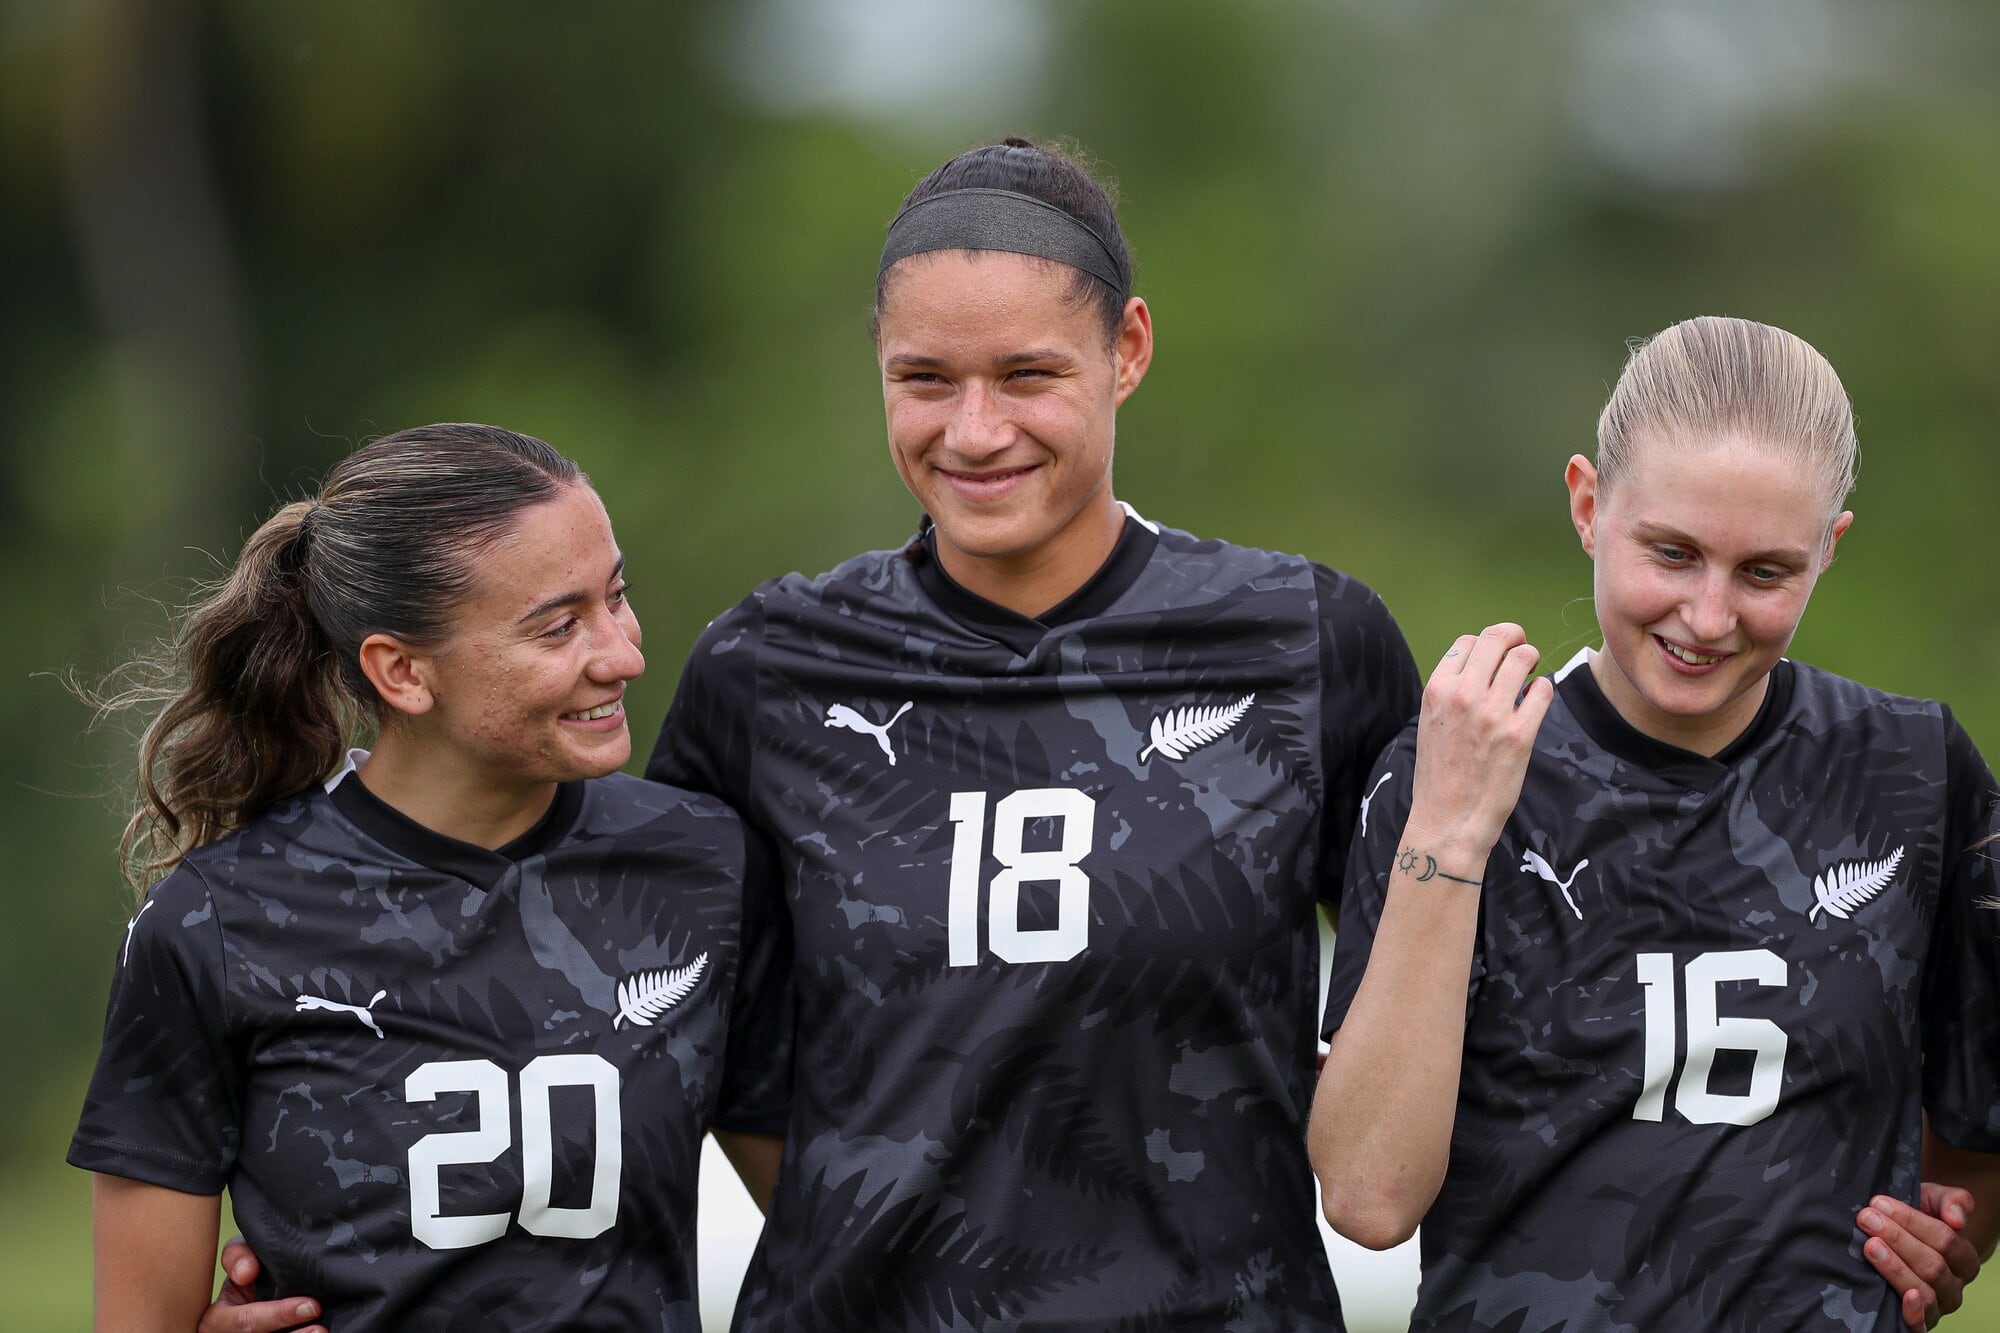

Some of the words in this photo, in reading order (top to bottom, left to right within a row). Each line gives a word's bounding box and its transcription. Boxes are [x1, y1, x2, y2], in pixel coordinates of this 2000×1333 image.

[949, 788, 1096, 968] 18
[1633, 949, 1788, 1126] 16
[404, 1053, 622, 1250] 20
